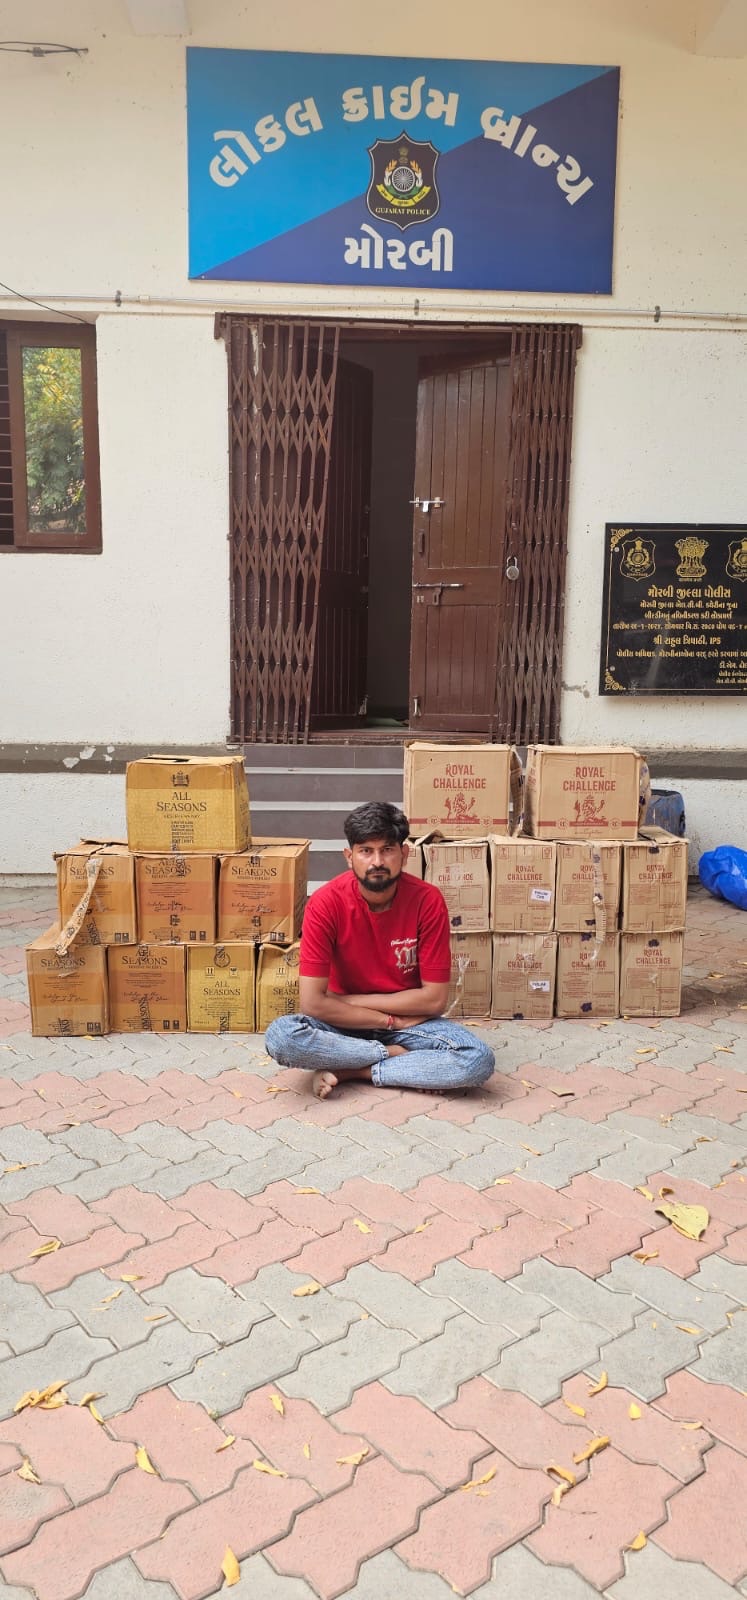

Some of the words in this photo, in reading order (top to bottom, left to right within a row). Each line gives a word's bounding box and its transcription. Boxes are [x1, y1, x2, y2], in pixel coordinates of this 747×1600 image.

[208, 97, 325, 188] લોકલ
[479, 106, 595, 206] બ્રાન્ચ
[375, 207, 405, 215] GUJARAT
[343, 223, 454, 273] મોરબી
[647, 584, 673, 598] મોરબી
[704, 584, 731, 598] પોલીસ
[653, 634, 663, 645] શ્રી
[709, 636, 721, 645] IPS
[445, 764, 475, 777] ROYAL
[575, 766, 605, 779] ROYAL
[433, 778, 486, 789] CHALLENGE
[563, 780, 616, 791] CHALLENGE
[172, 791, 192, 801] ALL
[156, 801, 207, 812] SEASONS
[515, 865, 535, 874] ROYAL
[507, 873, 543, 881] CHALLENGE
[643, 949, 663, 958] ROYAL
[635, 957, 672, 965] CHALLENGE
[214, 980, 230, 988] ALL
[203, 987, 241, 996] SEASONS
